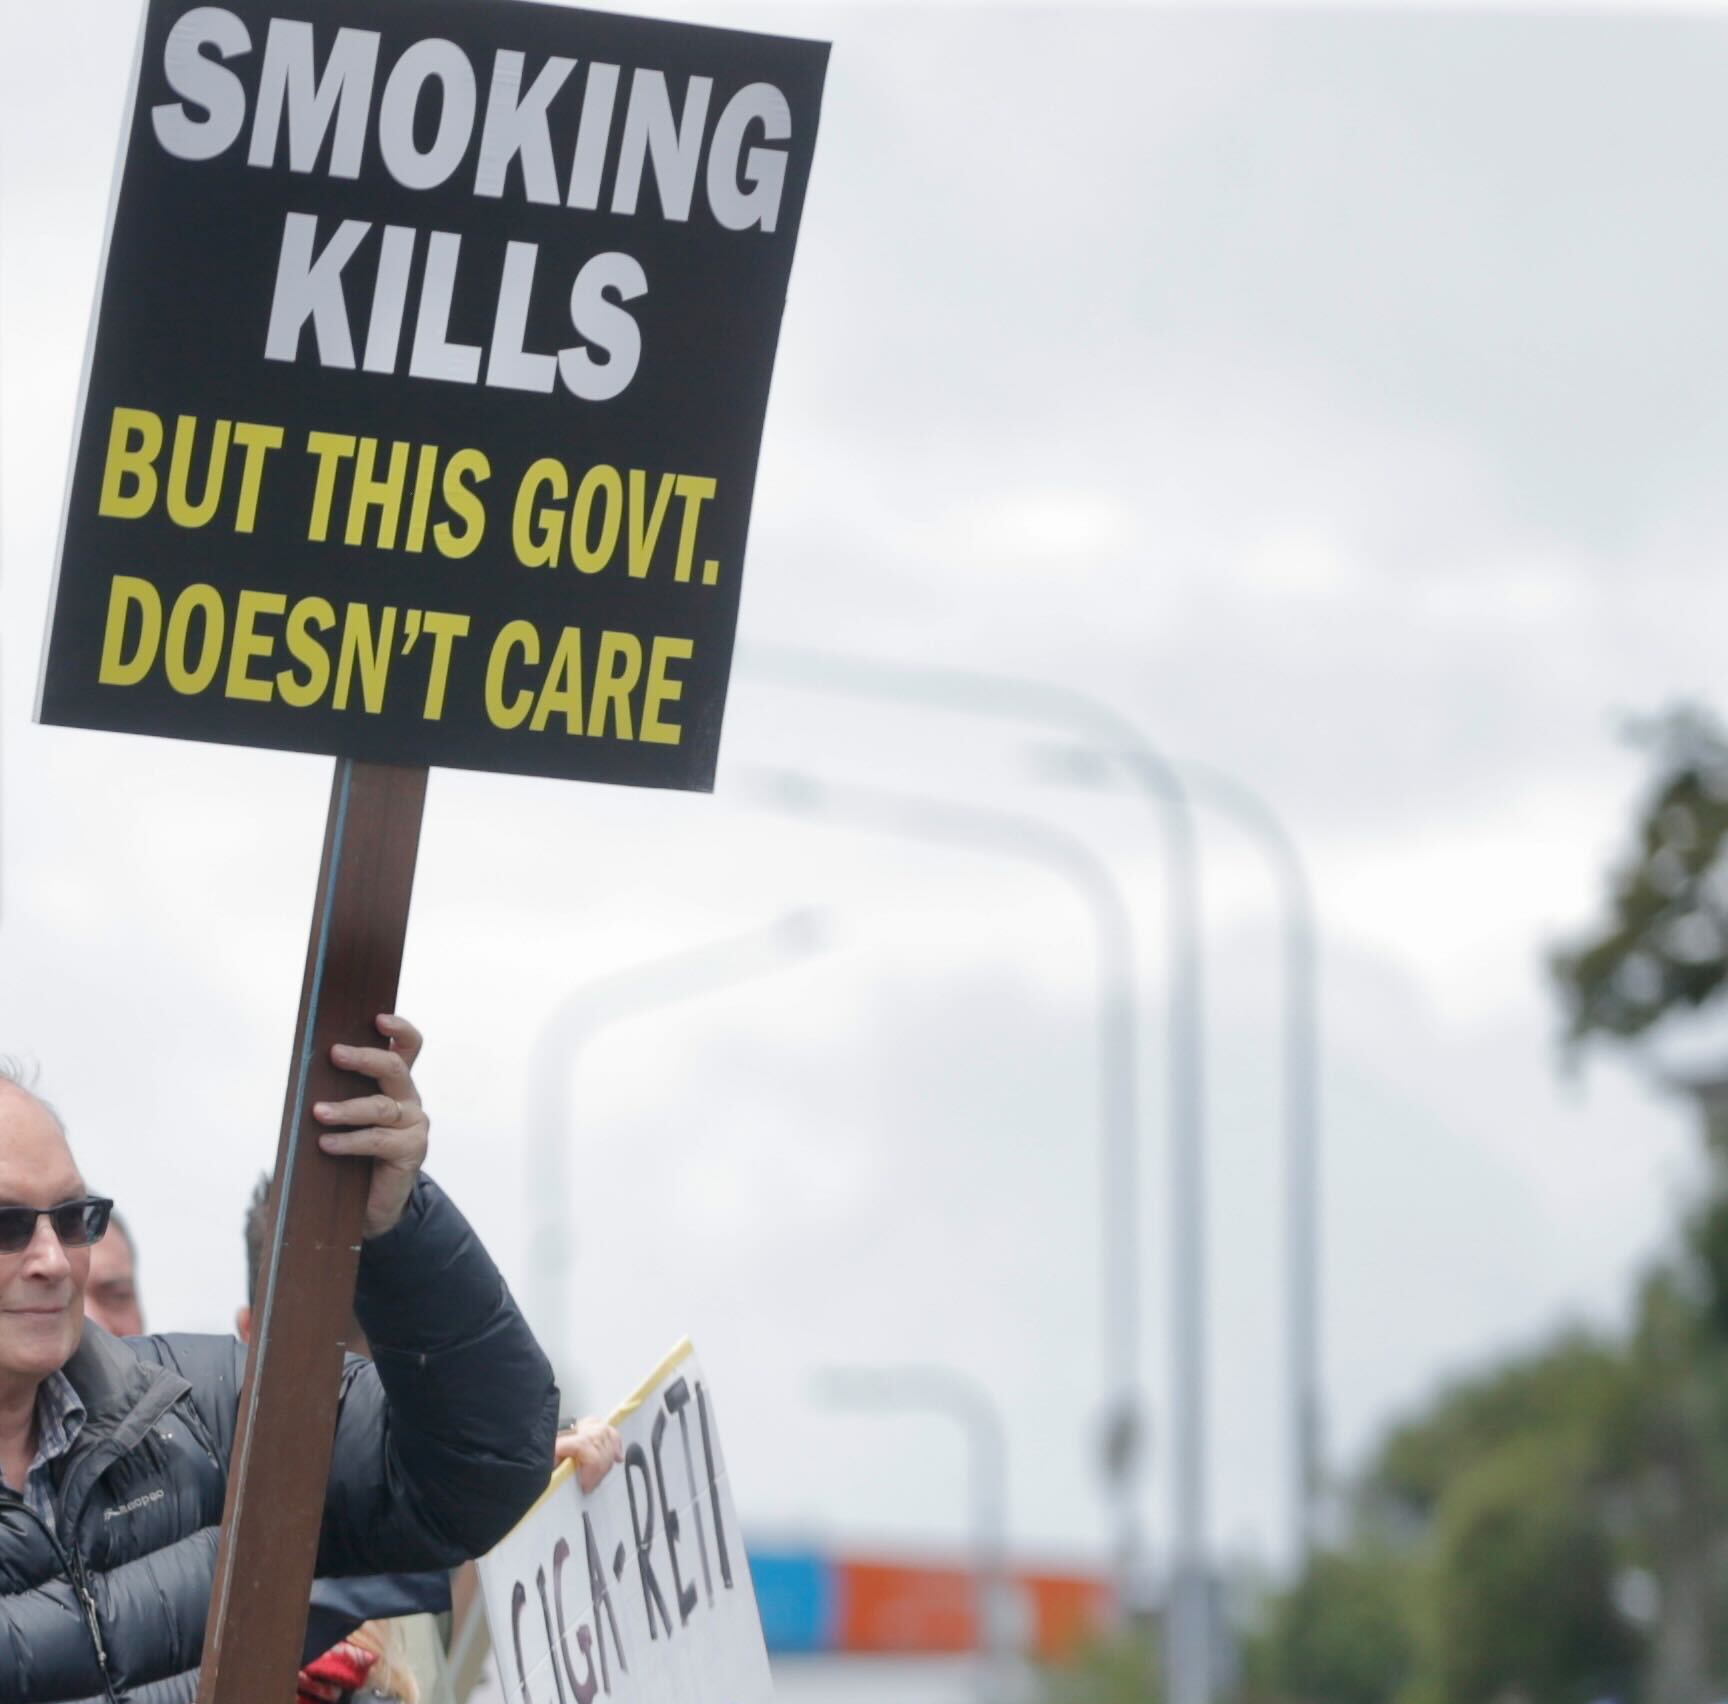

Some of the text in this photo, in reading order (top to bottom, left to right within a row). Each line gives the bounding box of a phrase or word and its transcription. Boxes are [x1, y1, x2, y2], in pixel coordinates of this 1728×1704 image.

[151, 5, 793, 233] SMOKING
[263, 211, 649, 401] KILLS
[97, 407, 720, 585] BUT THIS GOVT.
[97, 575, 694, 745] DOESN'T CARE
